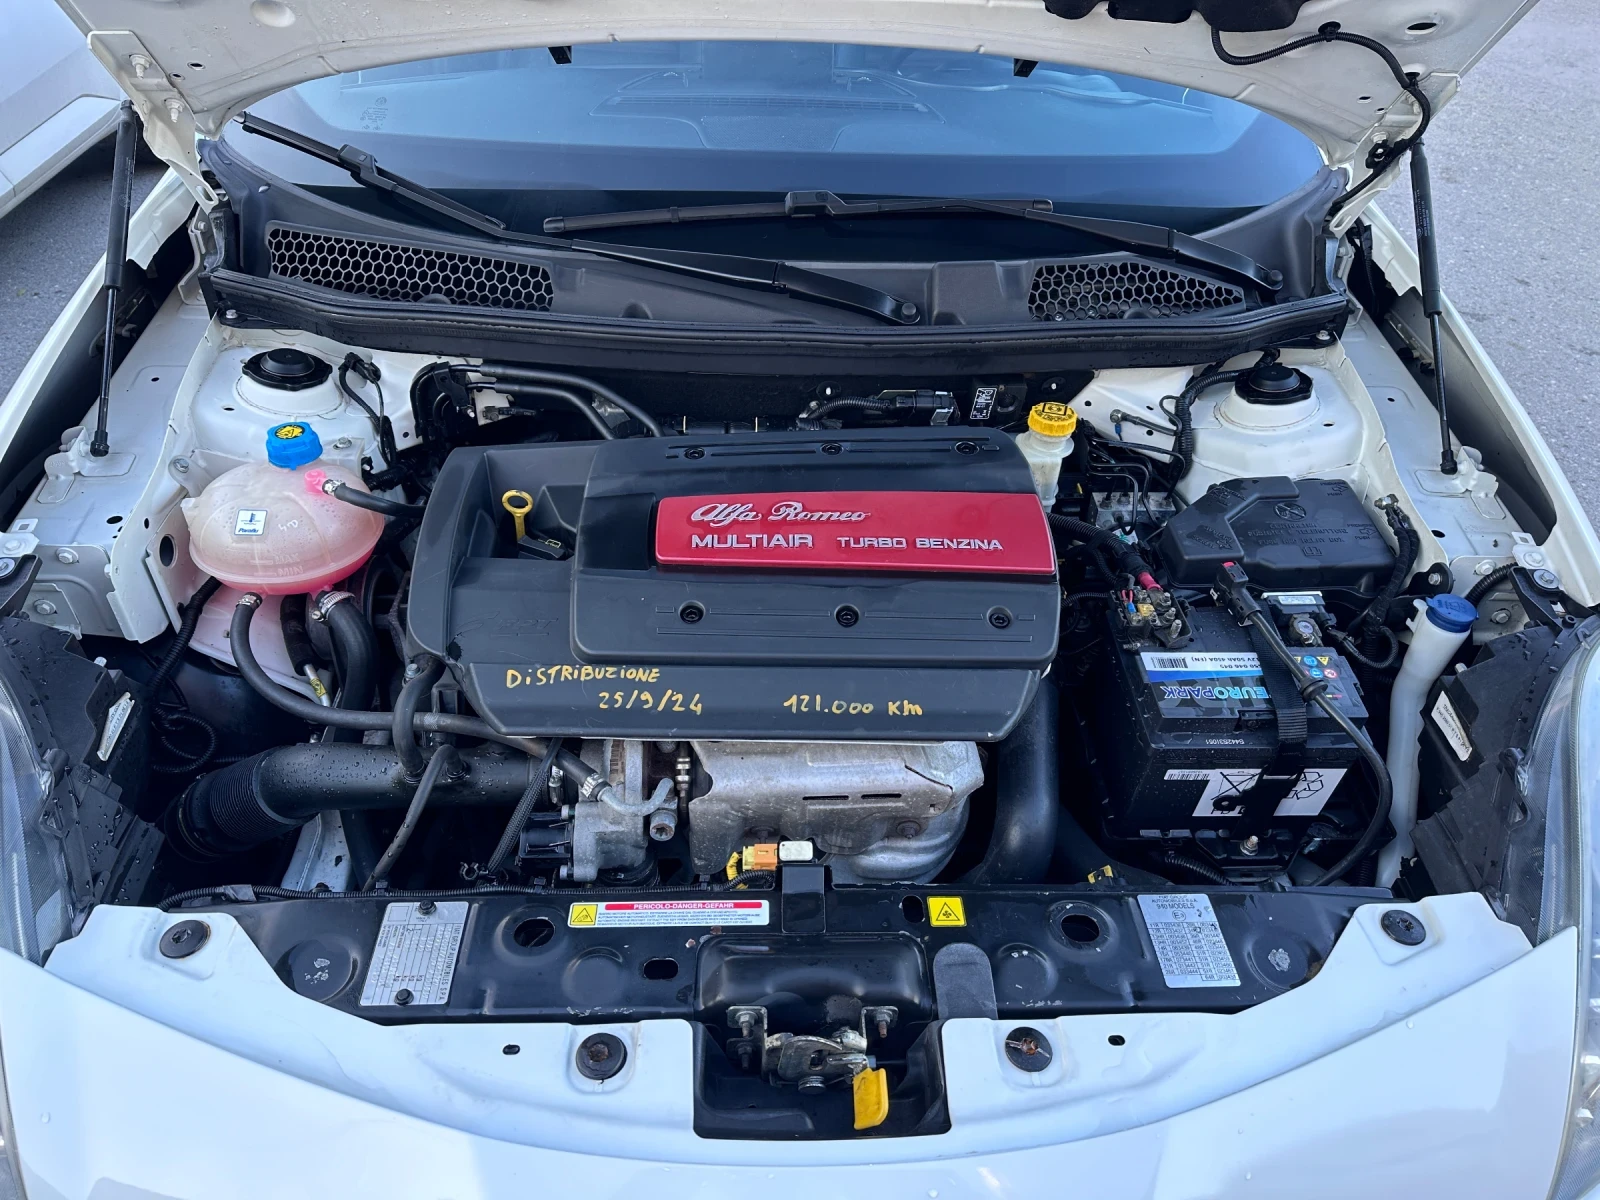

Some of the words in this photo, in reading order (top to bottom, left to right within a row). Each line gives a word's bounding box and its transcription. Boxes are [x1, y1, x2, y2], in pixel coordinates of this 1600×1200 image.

[691, 503, 762, 527] Alfa
[768, 501, 871, 523] Romeo
[691, 533, 814, 550] MULTIAIR
[836, 536, 907, 550] TURBO
[915, 537, 1004, 551] BENZINA
[274, 553, 300, 565] MAX
[277, 565, 304, 577] MIN
[1159, 686, 1271, 700] EUROPARK
[598, 689, 703, 716] 25/9/24
[782, 694, 874, 714] 121.000
[633, 902, 735, 910] PERICOLO-DANGER-GEFAHR
[1169, 902, 1195, 910] MODELS
